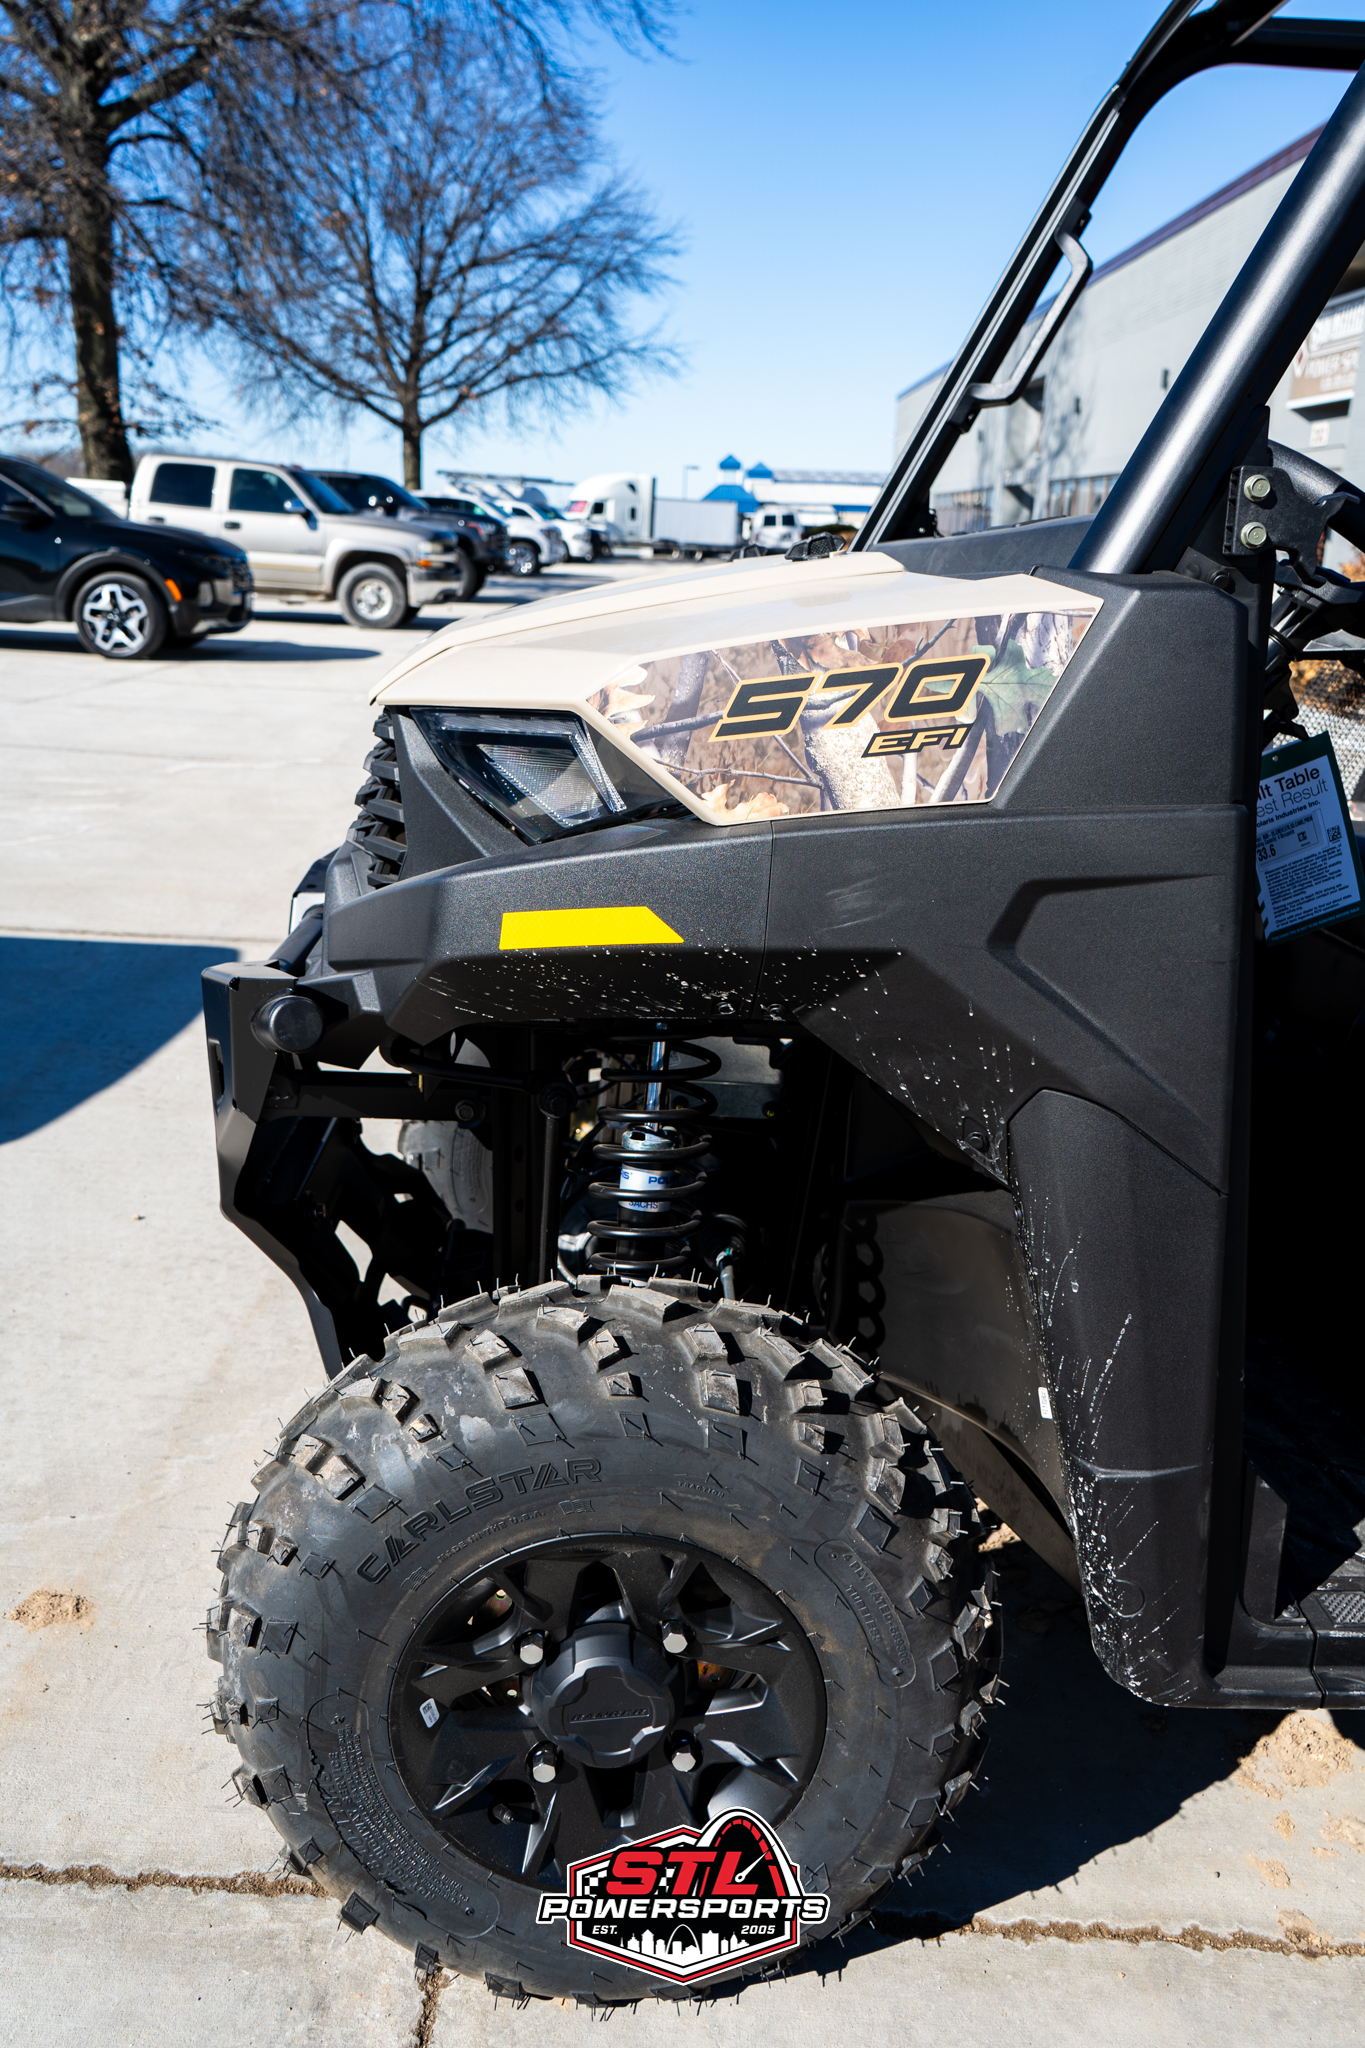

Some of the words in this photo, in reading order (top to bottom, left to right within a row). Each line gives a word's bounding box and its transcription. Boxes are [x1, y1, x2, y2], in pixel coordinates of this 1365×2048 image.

[708, 653, 991, 743] 570
[861, 724, 973, 758] EFI
[1274, 768, 1320, 792] Table
[1256, 798, 1279, 818] est
[1281, 779, 1328, 808] Result
[1256, 817, 1274, 828] olaris
[1275, 804, 1307, 820] Industries
[1308, 800, 1320, 808] Inc.
[1256, 844, 1276, 862] 33.6
[356, 1458, 602, 1584] CARLSTAR
[327, 1751, 355, 1806] SERVICE
[384, 1858, 412, 1883] FOR
